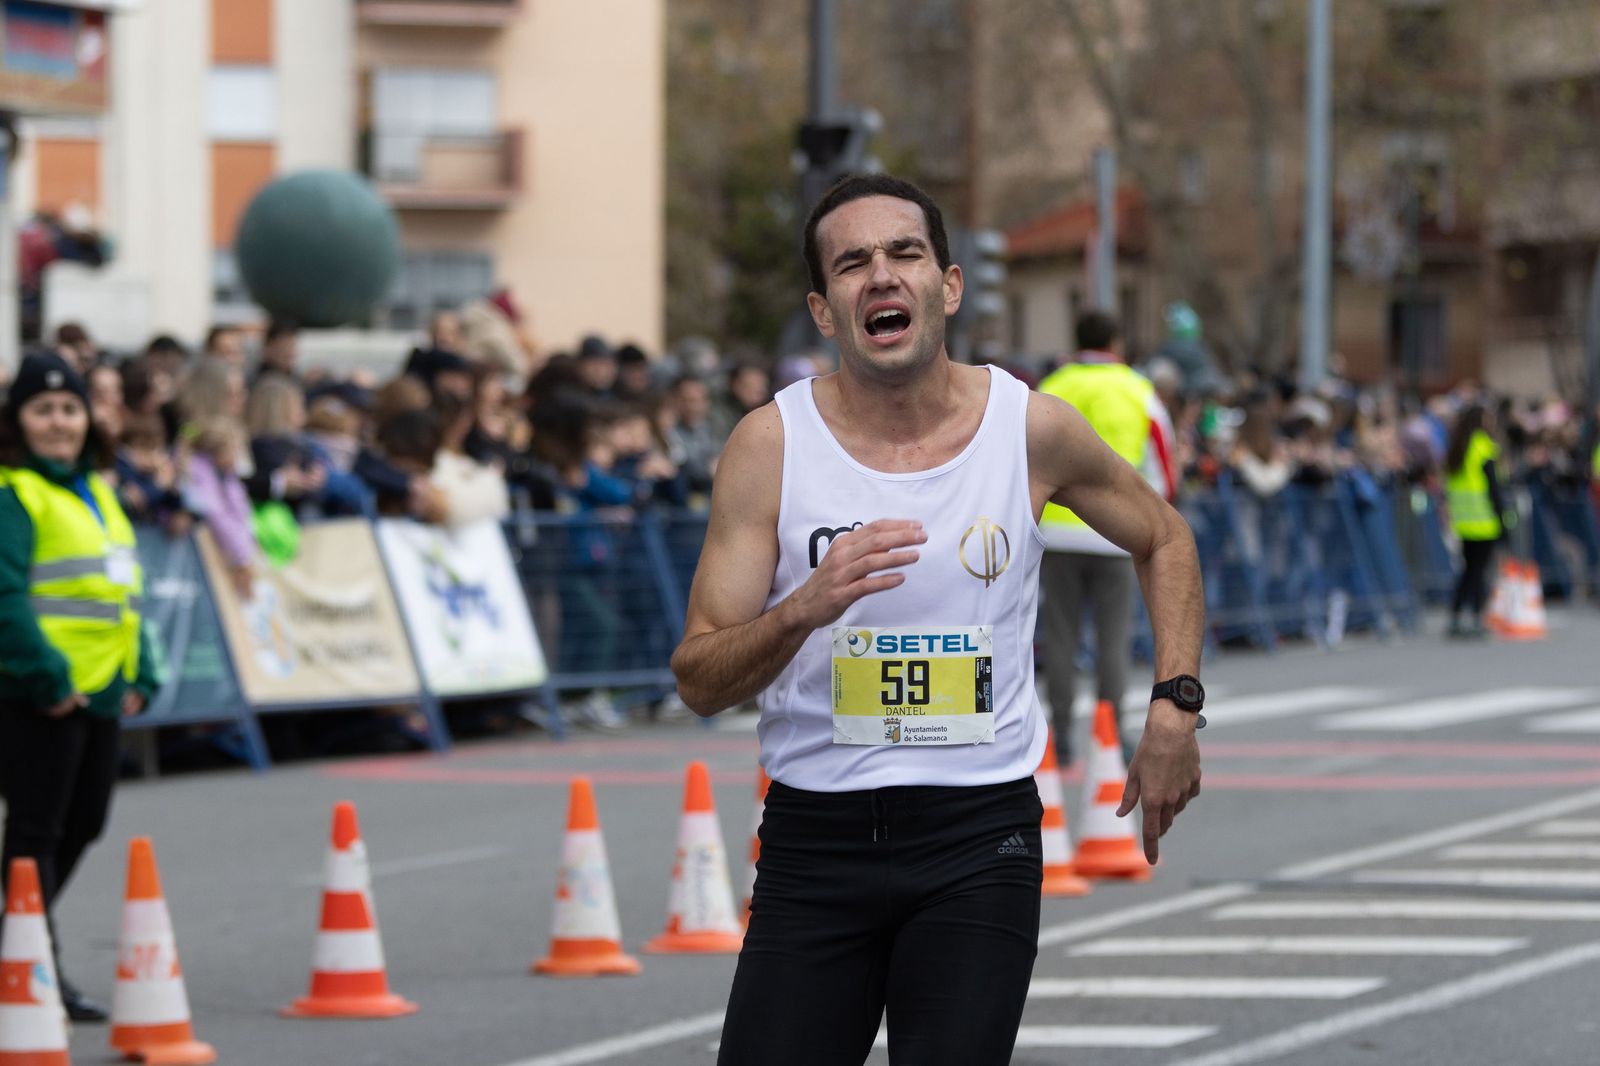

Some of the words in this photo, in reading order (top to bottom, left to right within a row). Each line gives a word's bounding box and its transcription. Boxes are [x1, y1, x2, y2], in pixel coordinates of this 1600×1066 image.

[876, 633, 979, 654] SETEL
[985, 665, 991, 674] 59
[881, 660, 930, 706] 59
[885, 706, 926, 716] DANIEL
[903, 725, 948, 735] Ayuntamiento
[904, 734, 912, 742] de
[913, 734, 948, 742] Salamanca
[997, 844, 1029, 855] adidas
